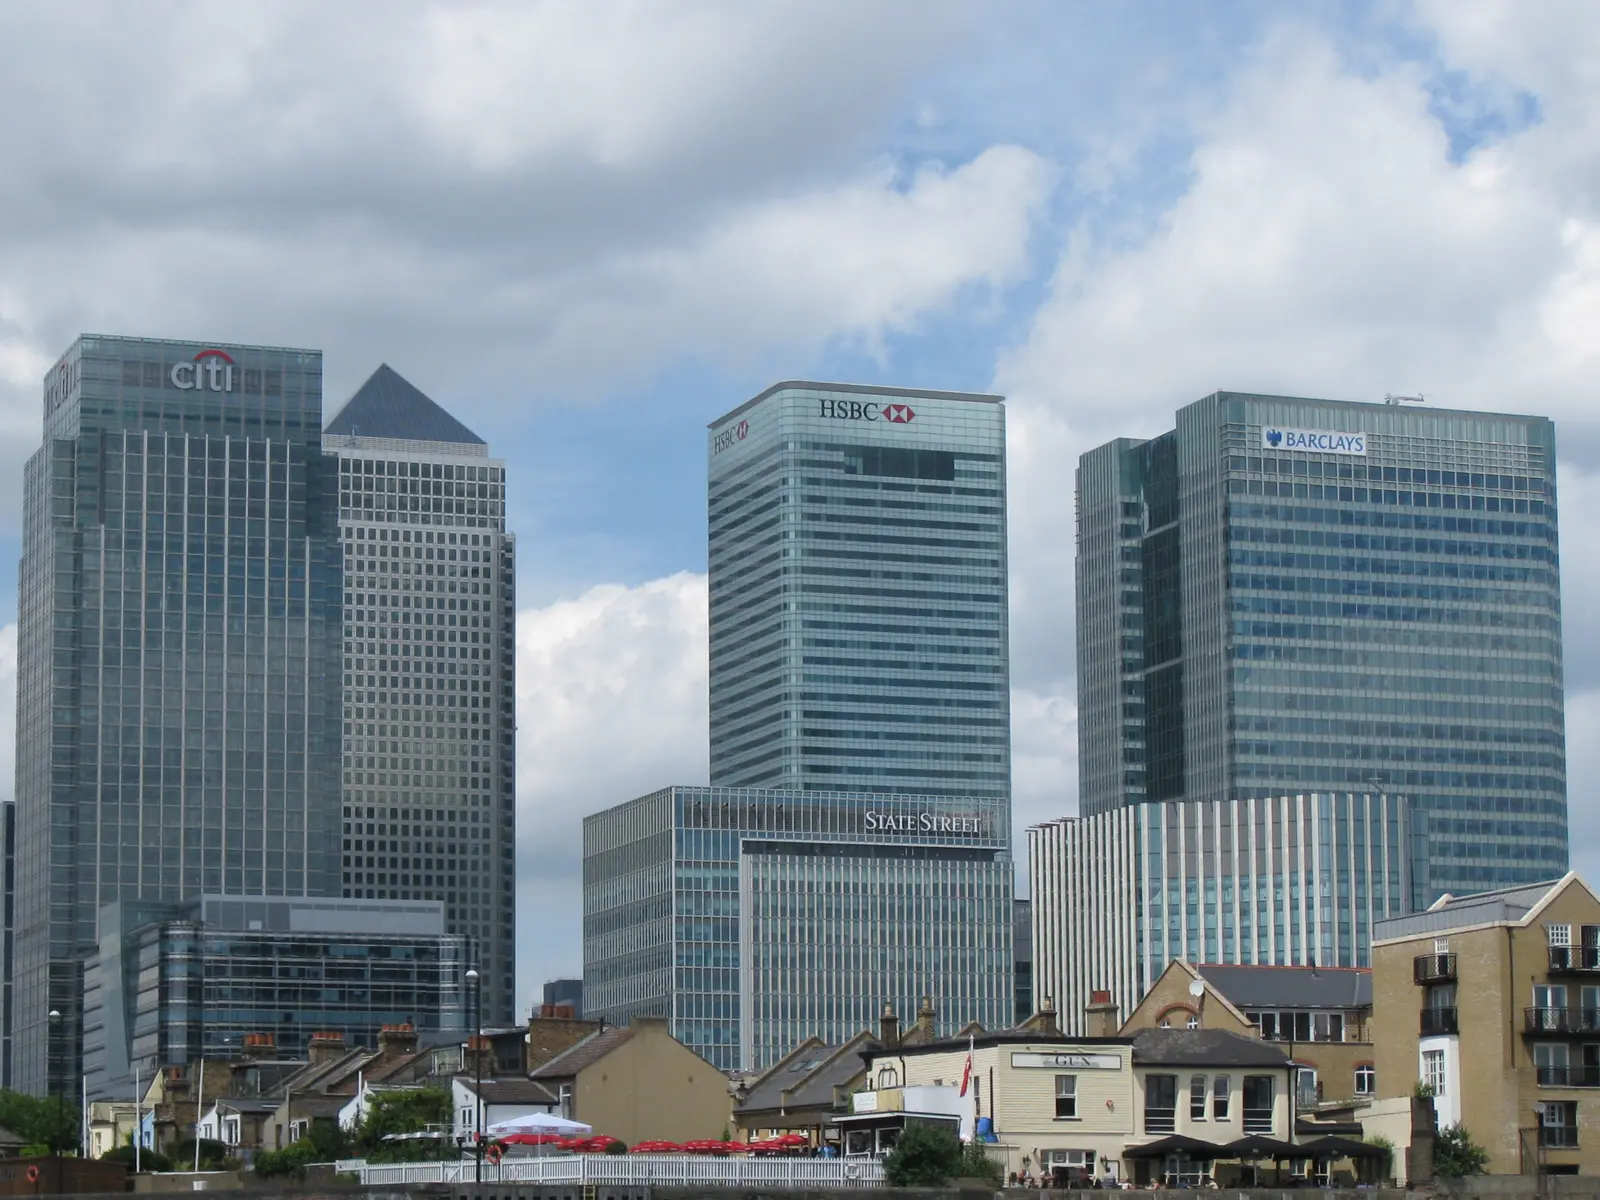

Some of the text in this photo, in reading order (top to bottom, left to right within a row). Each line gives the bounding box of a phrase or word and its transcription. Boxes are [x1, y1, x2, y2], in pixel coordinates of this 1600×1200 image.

[170, 355, 233, 392] citi
[819, 399, 880, 422] HSBC
[714, 426, 736, 455] HSBC
[1286, 432, 1364, 452] BARCLAYS
[865, 811, 981, 833] STATE STREET
[1055, 1055, 1091, 1067] GUN
